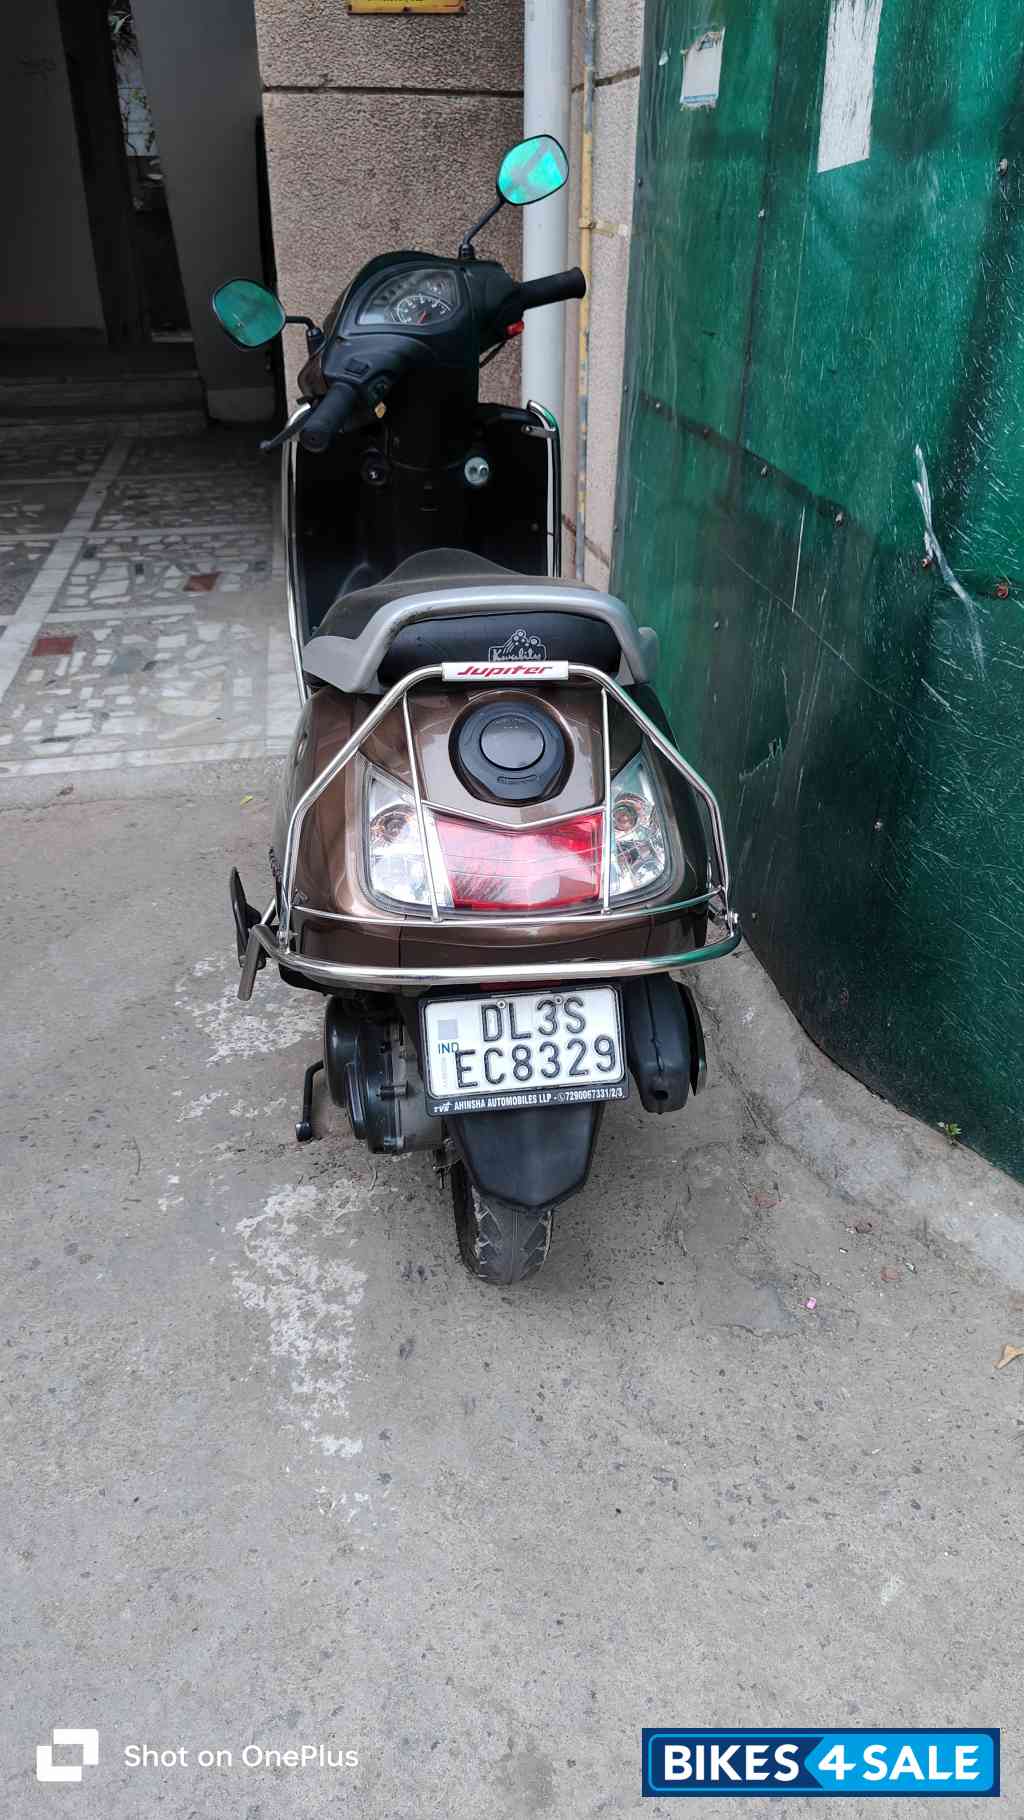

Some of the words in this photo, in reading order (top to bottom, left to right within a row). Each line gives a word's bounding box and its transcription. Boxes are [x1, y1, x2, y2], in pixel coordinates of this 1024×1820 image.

[458, 665, 552, 677] Jupiter
[481, 997, 585, 1042] DL3S
[438, 1042, 459, 1054] IND
[455, 1035, 616, 1088] EC8329
[454, 1099, 485, 1110] AHINSHA
[487, 1094, 537, 1107] AUTOMOBILES
[538, 1093, 551, 1103] LLP
